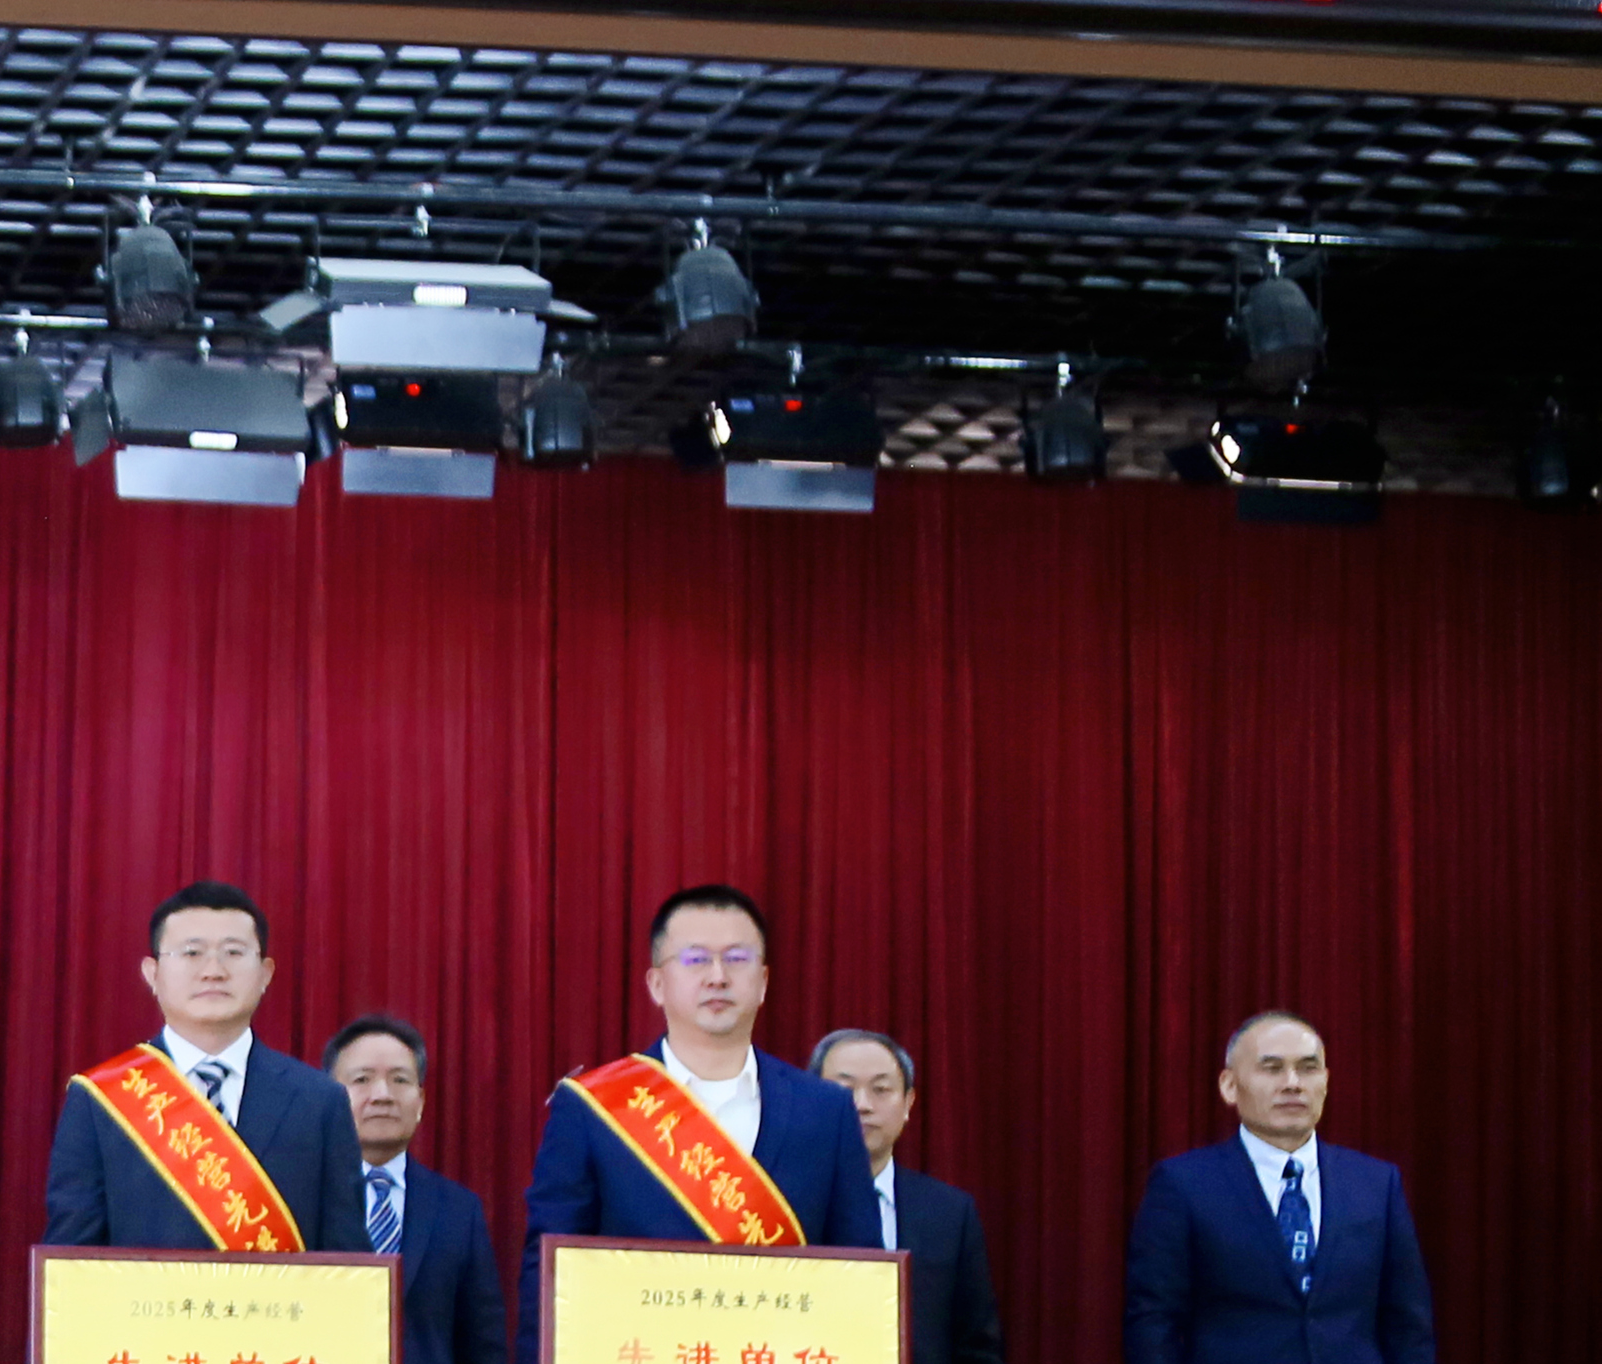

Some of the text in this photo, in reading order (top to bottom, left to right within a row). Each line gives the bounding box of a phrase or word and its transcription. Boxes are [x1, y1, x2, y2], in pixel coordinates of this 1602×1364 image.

[628, 1086, 784, 1245] 生产经营先
[130, 1298, 304, 1322] 2025年度生产经营
[640, 1288, 814, 1313] 2025年度生产经营
